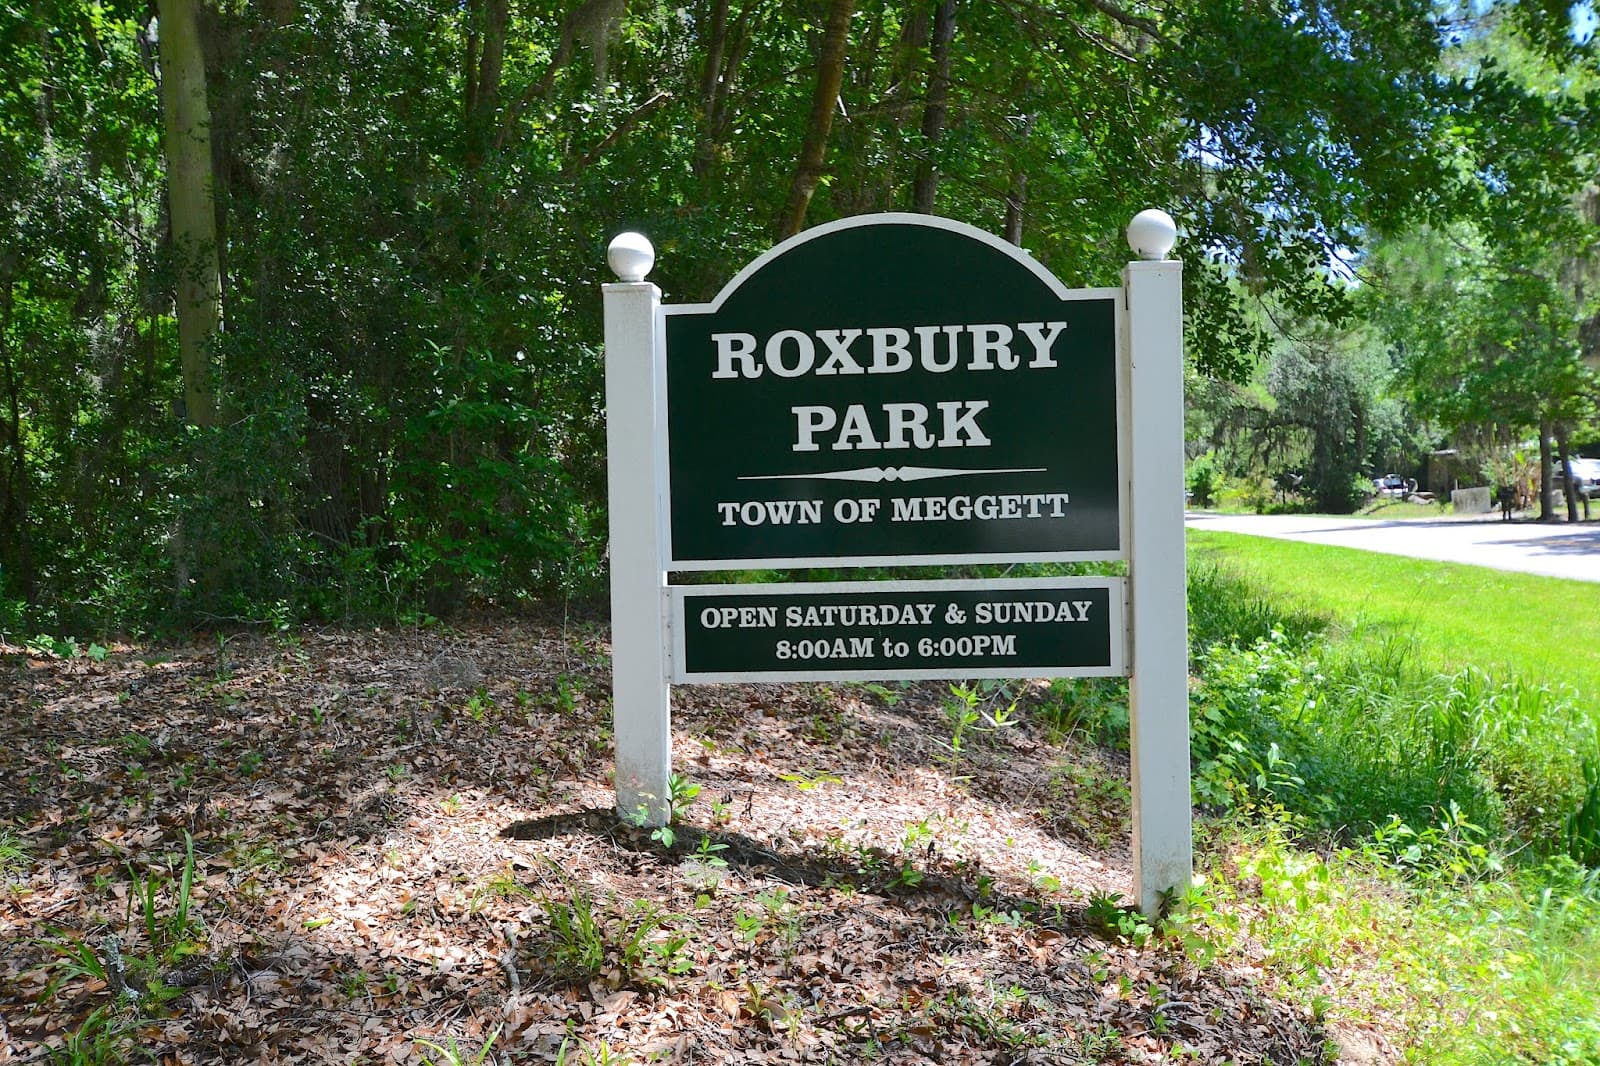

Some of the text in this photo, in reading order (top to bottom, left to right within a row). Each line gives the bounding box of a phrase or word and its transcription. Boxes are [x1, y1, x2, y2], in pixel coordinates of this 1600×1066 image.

[711, 321, 1068, 379] ROXBURY
[791, 400, 991, 453] PARK
[717, 493, 1069, 527] TOWN OF MEGGETT
[700, 600, 1093, 630] OPEN SATURDAY & SUNDAY
[775, 634, 1017, 660] 8:00AM to 6:00PM
